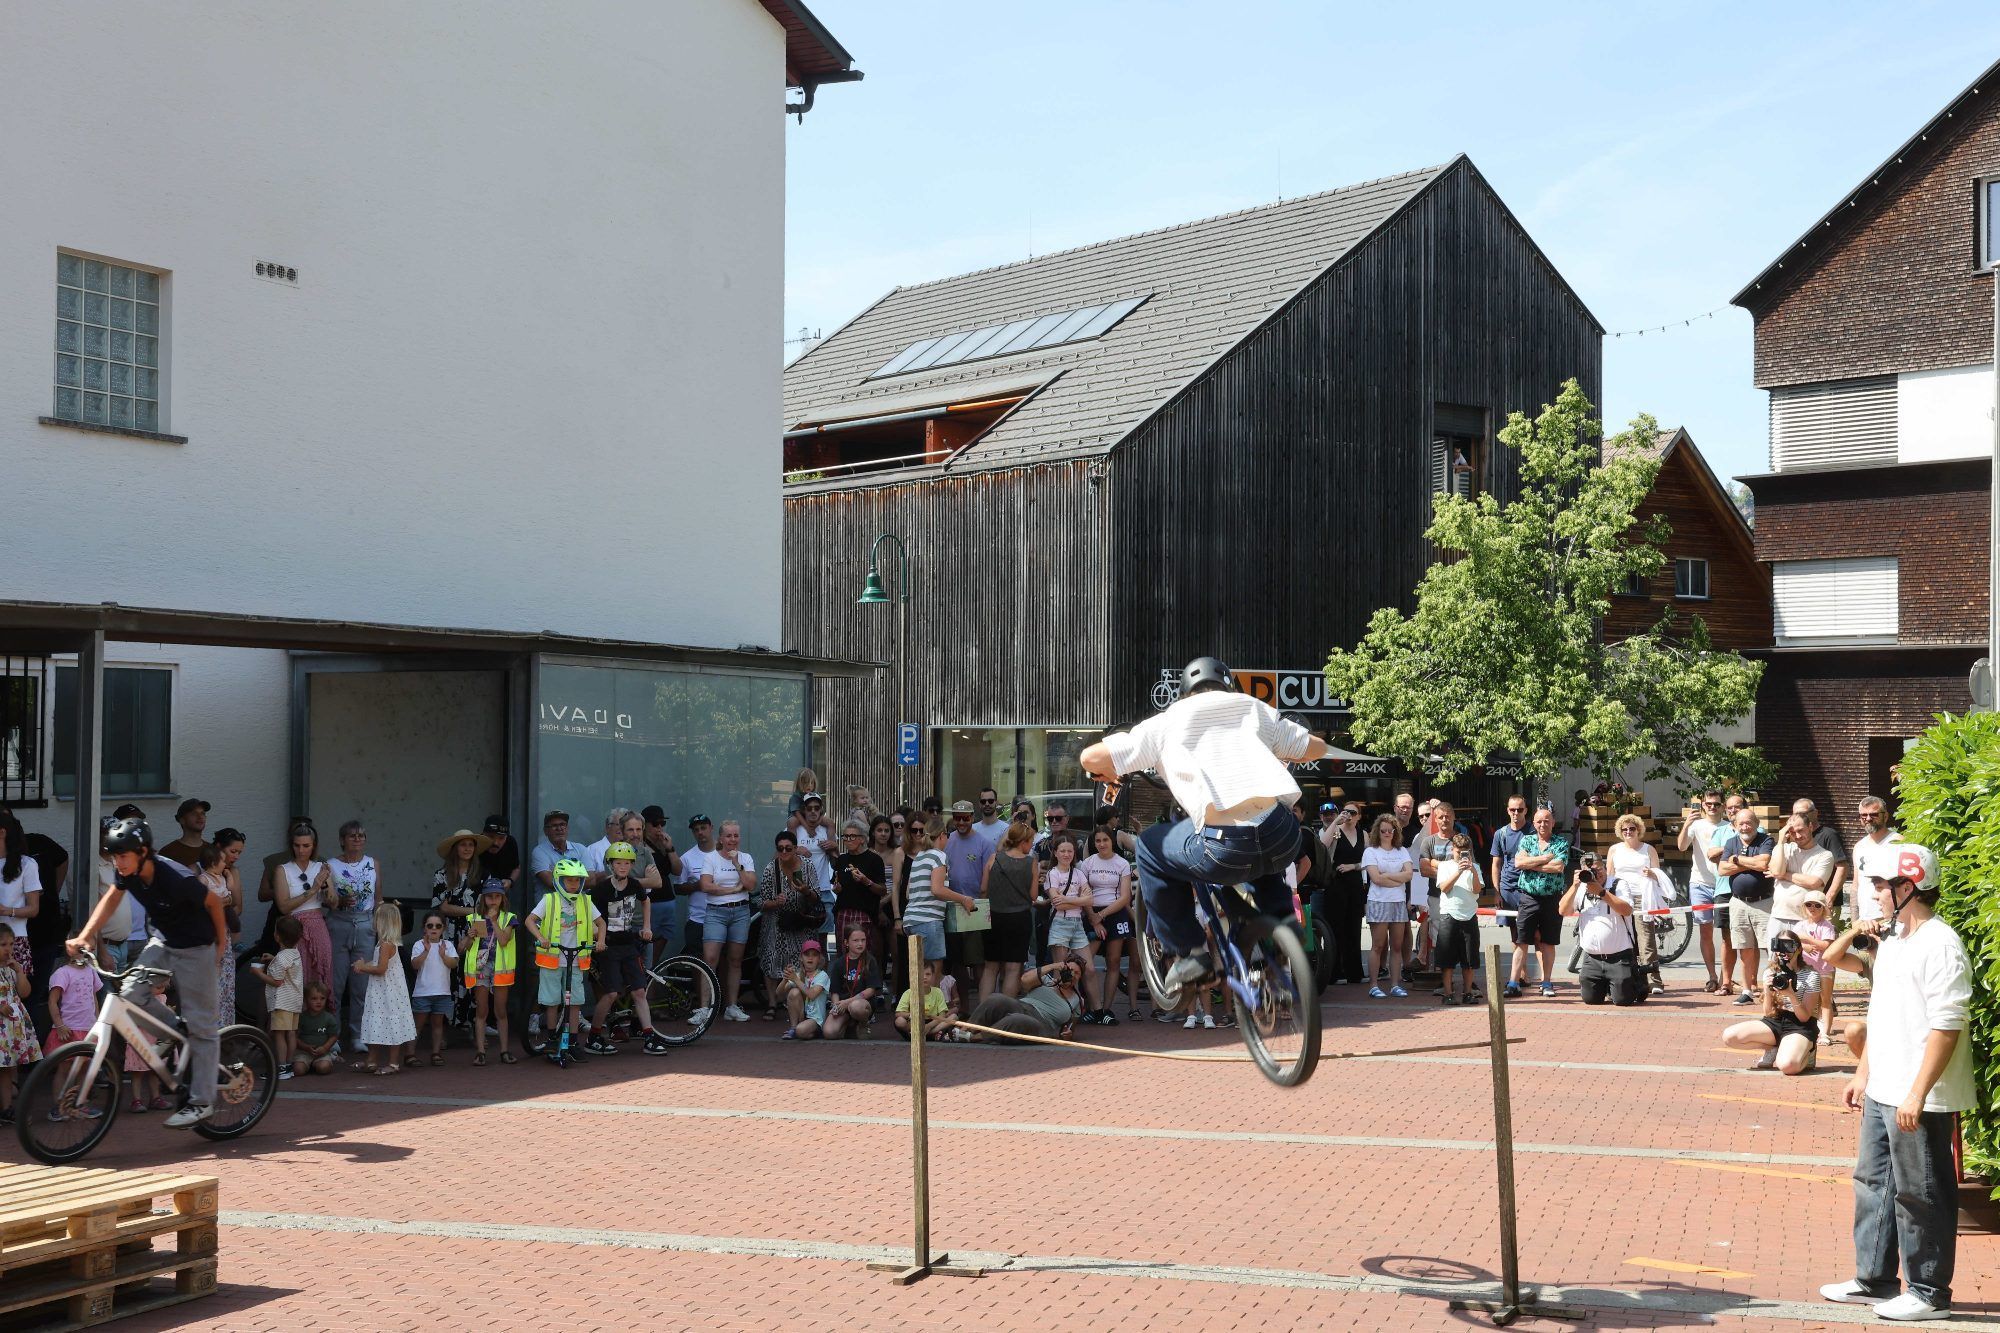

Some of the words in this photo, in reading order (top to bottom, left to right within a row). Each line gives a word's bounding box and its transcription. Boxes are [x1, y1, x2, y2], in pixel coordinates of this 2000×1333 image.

[1279, 676, 1346, 707] CUL
[901, 726, 917, 754] P
[1345, 762, 1387, 774] 24MX
[1116, 921, 1130, 935] 98
